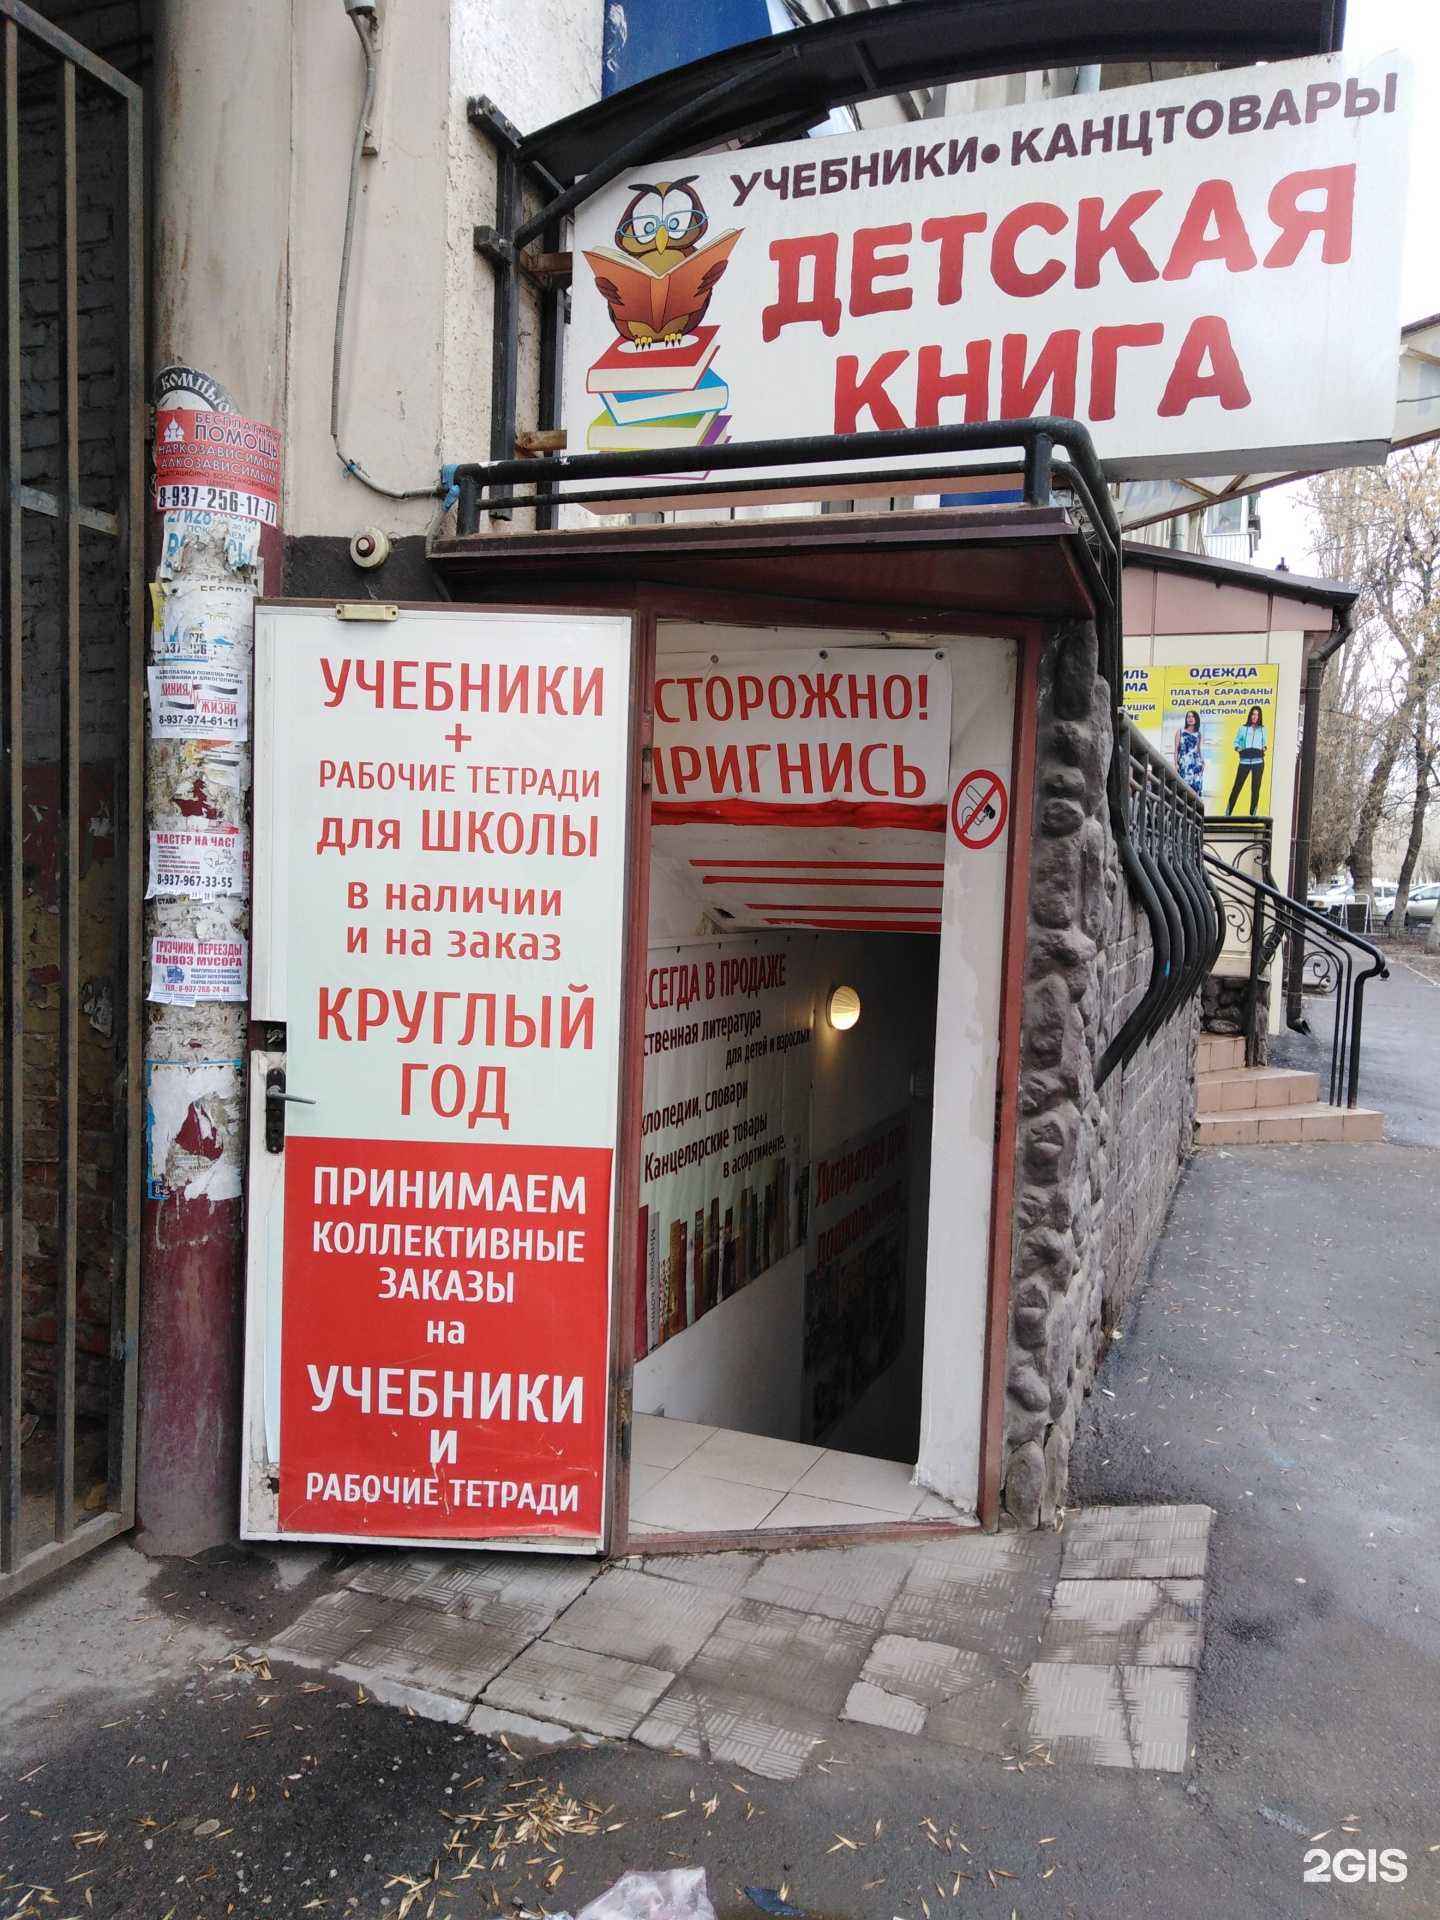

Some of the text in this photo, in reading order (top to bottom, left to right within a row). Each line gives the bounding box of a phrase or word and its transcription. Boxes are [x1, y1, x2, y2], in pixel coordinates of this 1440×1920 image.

[731, 72, 1397, 207] УЧЕБНИКИ КАНЦТОВАРЫ
[762, 163, 1357, 342] ДЕТСКАЯ
[833, 316, 1252, 435] КНИГА
[158, 441, 280, 474] НАРКОЗАВИСИМЫМ
[195, 425, 278, 460] ПОМОЩЬ
[160, 456, 276, 488] АЛКОЗАВИСИМЫМ
[159, 486, 277, 527] 8-937-256-17-77
[320, 658, 604, 716] УЧЕБНИКИ
[1170, 687, 1273, 696] ПЛАТЬЯ САРАФАНЫ
[1190, 667, 1258, 679] ОДЕЖДА
[1171, 698, 1216, 707] ОДЕЖДА
[1239, 698, 1271, 706] ДОМА
[319, 760, 600, 802] РАБОЧИЕ ТЕТРАДИ
[317, 810, 599, 857] для ШКОЛЫ
[347, 881, 562, 917] в наличии
[156, 955, 243, 966] ВЫВОЗ МУСОРА
[347, 927, 562, 961] и на заказ
[645, 953, 786, 1013] СЕГДА В ПРОДАЖЕ
[318, 983, 595, 1050] КРУГЛЫЙ
[702, 1007, 762, 1051] литература
[401, 1063, 510, 1131] ГОД
[704, 1078, 749, 1114] словари
[645, 1112, 768, 1183] Канцелярские товары
[313, 1166, 586, 1214] ПРИНИМАЕМ
[312, 1221, 585, 1263] КОЛЛЕКТИВНЫЕ
[378, 1267, 514, 1303] ЗАКАЗЫ
[427, 1320, 465, 1345] на
[306, 1364, 584, 1424] УЧЕБНИКИ
[430, 1429, 458, 1464] И
[306, 1472, 579, 1516] РАБОЧИЕ ТЕТРАДИ
